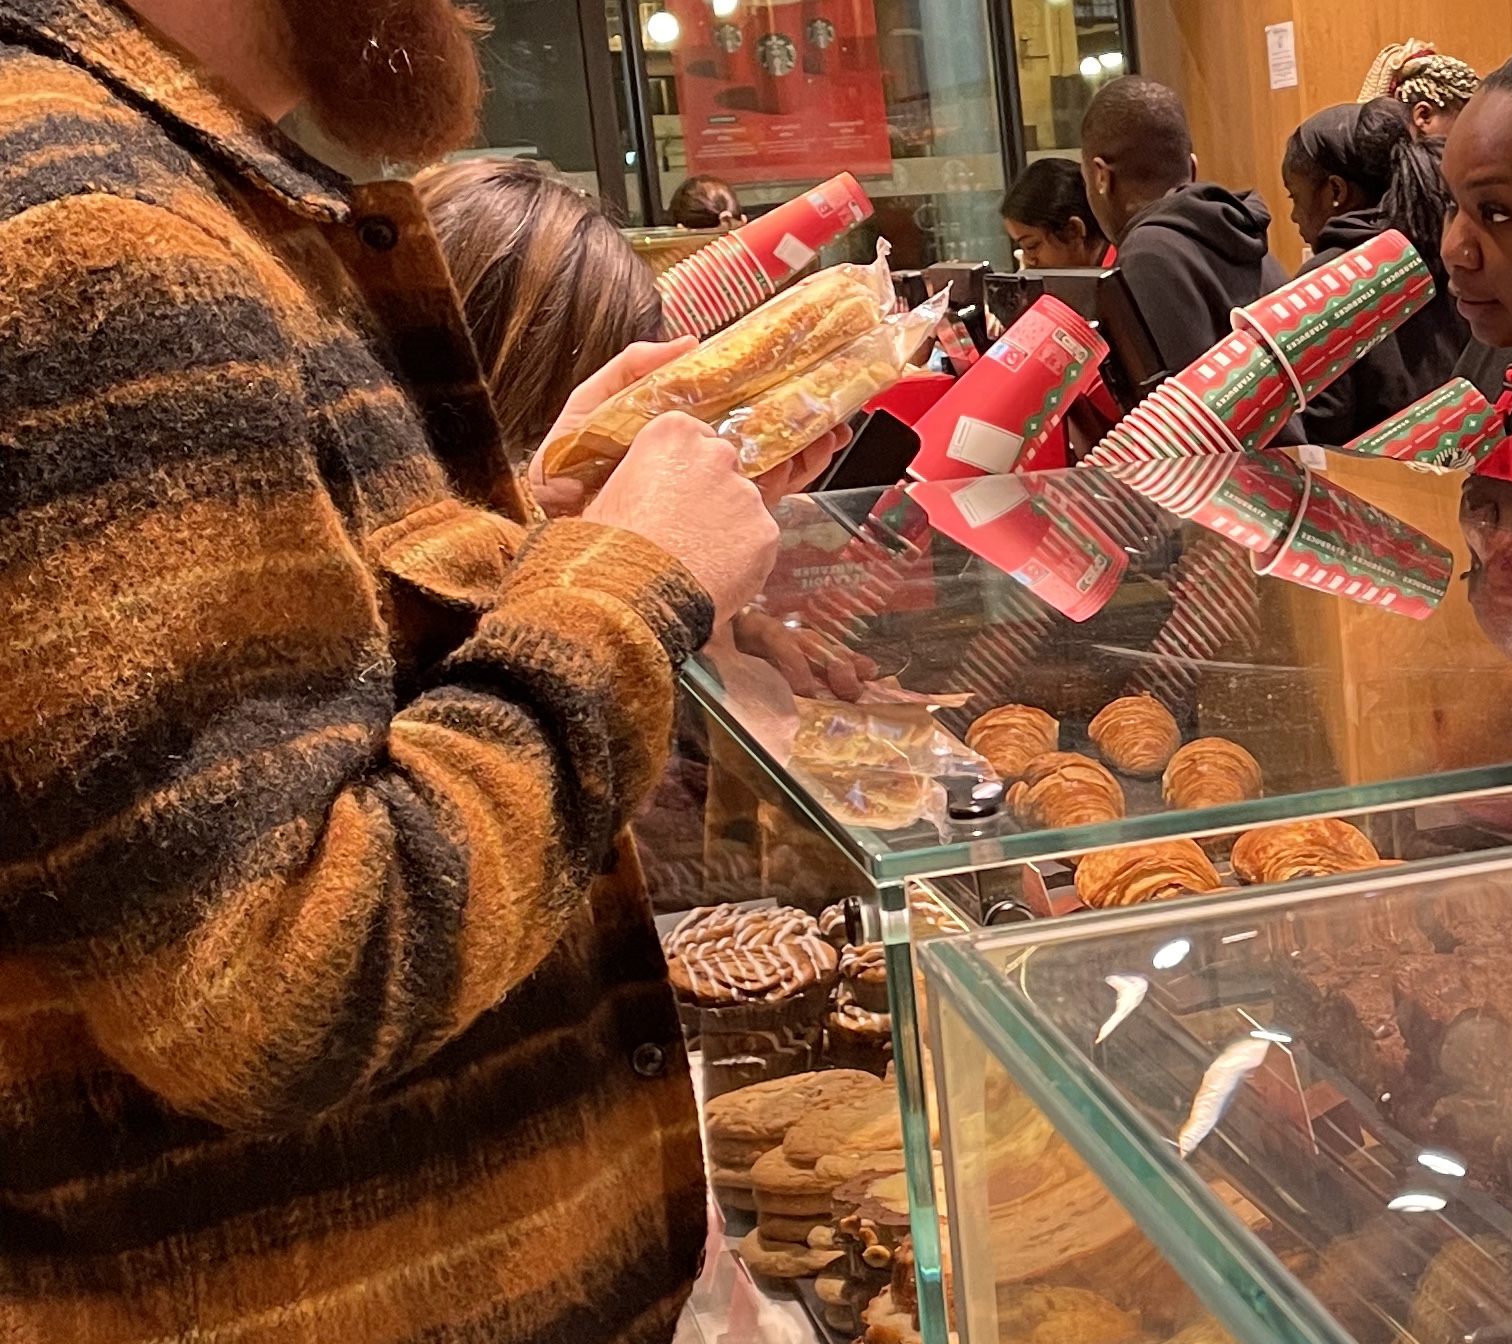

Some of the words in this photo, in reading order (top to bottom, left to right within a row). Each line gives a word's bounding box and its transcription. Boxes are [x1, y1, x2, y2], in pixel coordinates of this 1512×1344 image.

[1333, 289, 1377, 320] STARBUCKS
[1285, 319, 1330, 353] STARBUCKS
[1214, 371, 1257, 409] STARBUCKS
